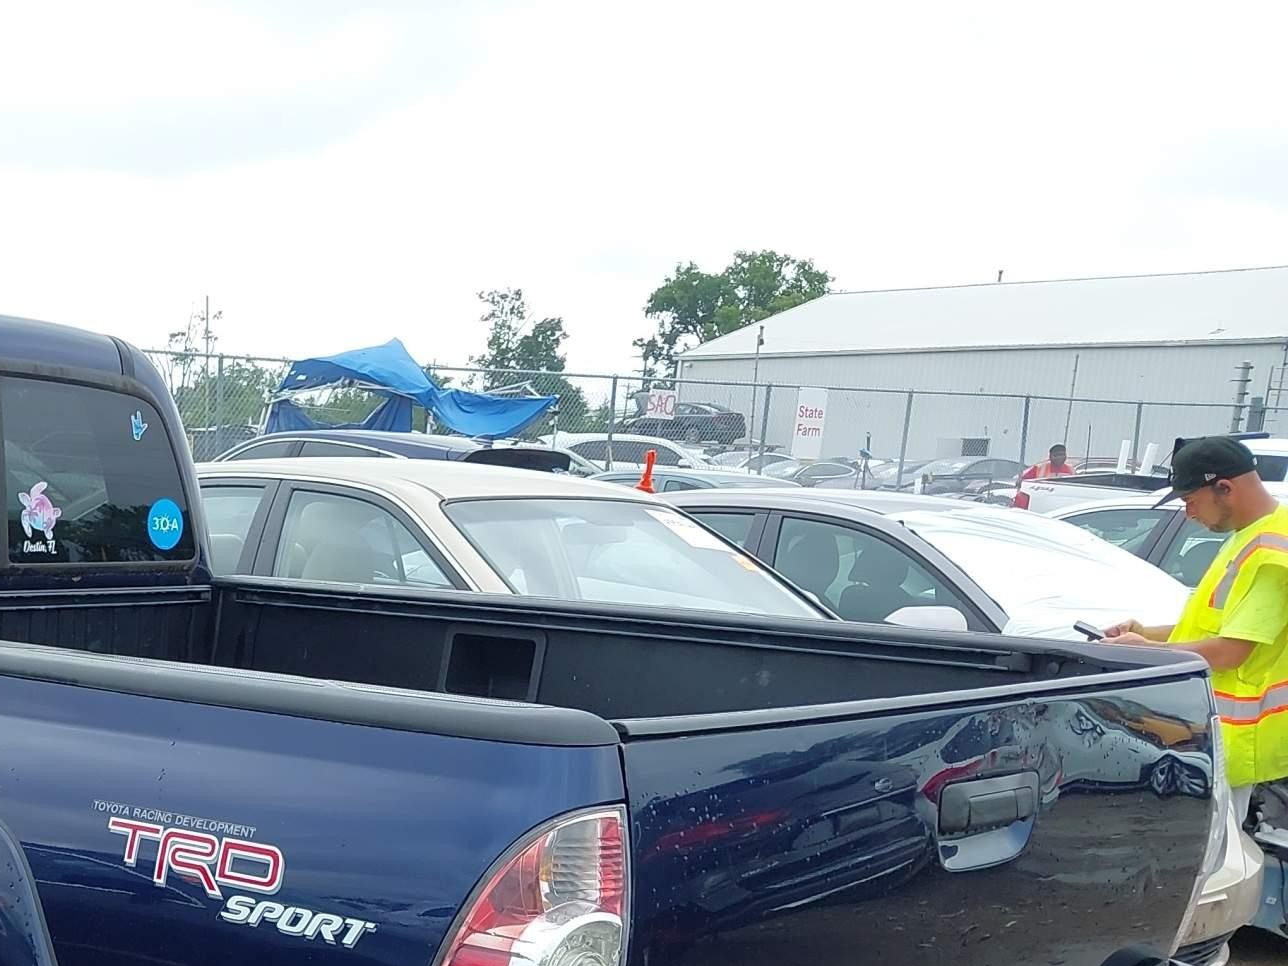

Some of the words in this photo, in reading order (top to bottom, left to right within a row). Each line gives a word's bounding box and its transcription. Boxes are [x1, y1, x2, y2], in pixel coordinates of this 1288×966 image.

[798, 405, 824, 419] State
[797, 424, 821, 437] Farm
[23, 540, 47, 553] Destin,
[46, 540, 58, 555] FL
[93, 800, 130, 817] TOYOTA
[132, 808, 172, 825] RACING
[174, 815, 257, 839] DEVELOPMENT
[108, 817, 285, 900] TRD
[220, 895, 379, 949] SPORT
